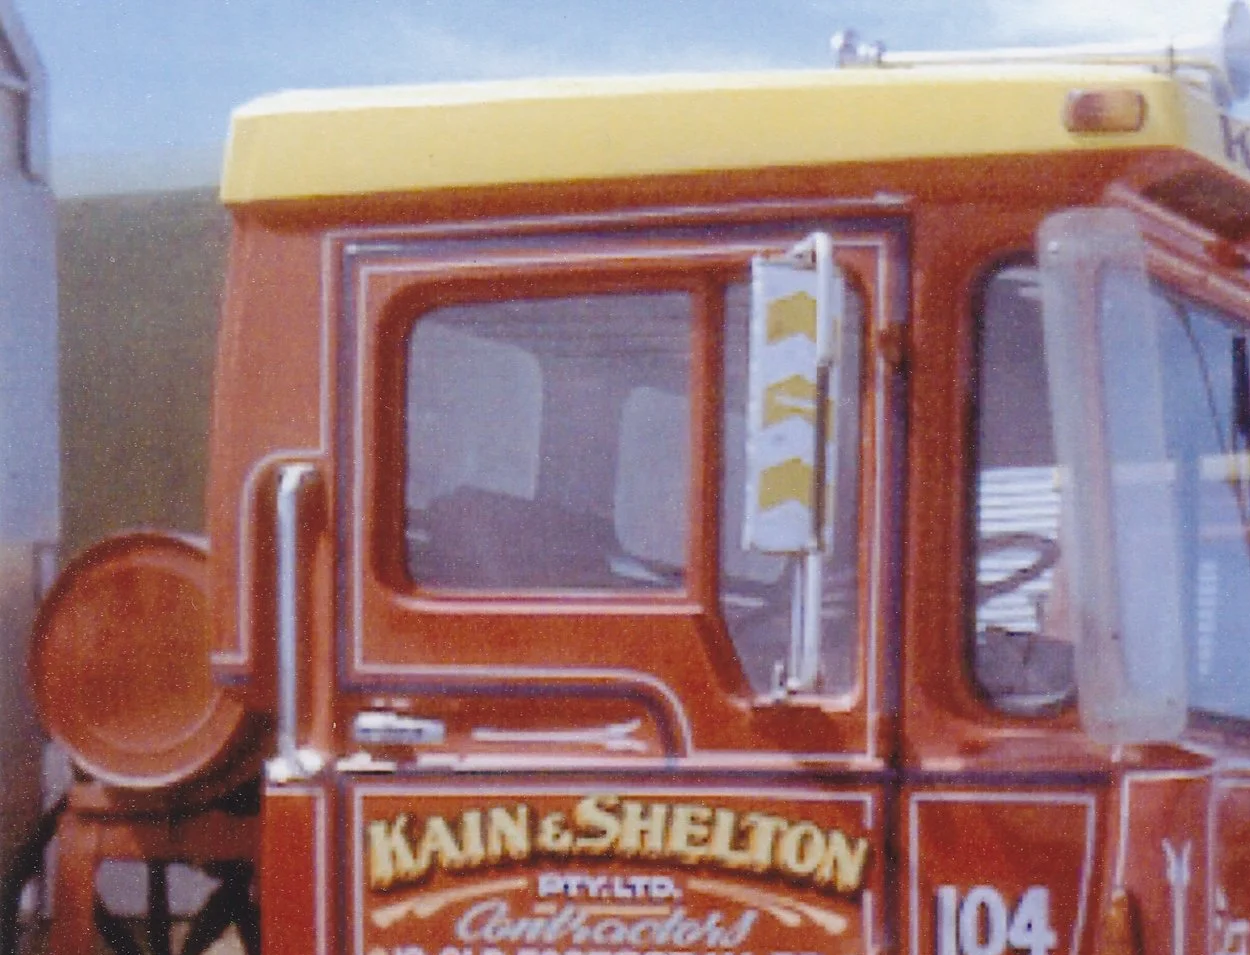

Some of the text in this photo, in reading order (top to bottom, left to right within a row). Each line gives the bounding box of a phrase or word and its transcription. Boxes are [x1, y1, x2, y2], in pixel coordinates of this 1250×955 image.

[369, 793, 868, 891] KAIN & SHELTON
